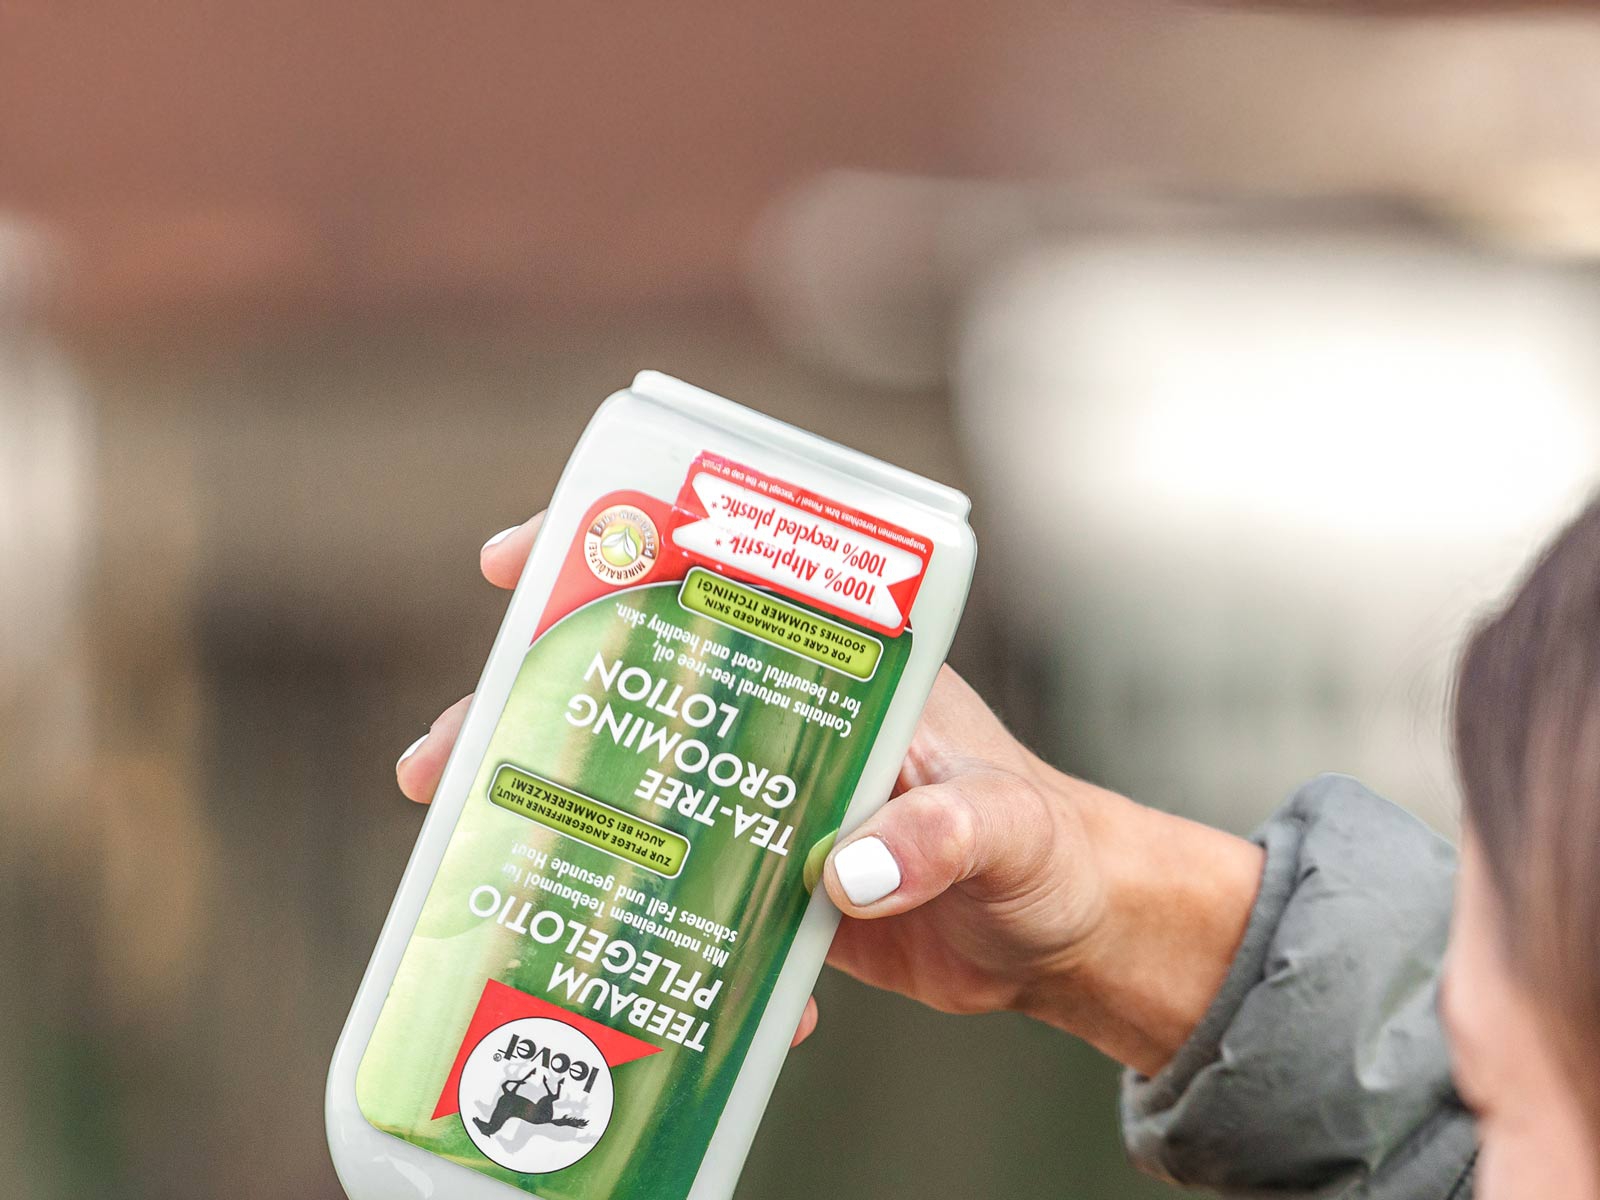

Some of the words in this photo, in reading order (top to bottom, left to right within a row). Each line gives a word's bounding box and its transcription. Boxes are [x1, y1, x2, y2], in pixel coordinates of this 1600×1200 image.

[772, 516, 839, 552] recycled
[842, 542, 887, 577] 100%
[696, 577, 759, 611] ITCHING!
[823, 567, 875, 605] 100%
[615, 601, 646, 628] skin.
[703, 594, 731, 615] SKIN,
[760, 603, 818, 635] SUMMER
[646, 613, 701, 654] healthy
[732, 608, 785, 637] DAMAGED
[786, 631, 801, 643] OF
[652, 639, 675, 662] oil,
[697, 638, 730, 660] and
[802, 637, 829, 654] CARE
[819, 627, 866, 653] SOOTHES
[730, 650, 763, 673] coat
[830, 648, 851, 664] FOR
[676, 653, 736, 689] tea-tree
[761, 664, 827, 705] beautiful
[583, 651, 739, 737] LOTION
[735, 677, 791, 709] natural
[828, 690, 840, 704] a
[839, 695, 861, 719] for
[791, 700, 852, 738] Contains
[564, 693, 796, 805] GROOMING
[496, 784, 525, 806] HAUT,
[510, 777, 615, 828] SOMMEREKZEM!
[525, 799, 610, 840] ANGEGRIFFENER
[633, 767, 793, 856] TEA-TREE
[615, 820, 634, 835] BEI
[634, 828, 666, 847] AUCH
[609, 834, 648, 857] PFLEGE
[648, 850, 672, 867] ZUR
[549, 857, 615, 892] gesunde
[612, 883, 646, 905] und
[645, 896, 677, 923] Fell
[608, 904, 701, 952] naturreinem
[678, 910, 738, 943] schönes
[701, 943, 730, 968] Mit
[546, 961, 710, 1052] TEEBAUM
